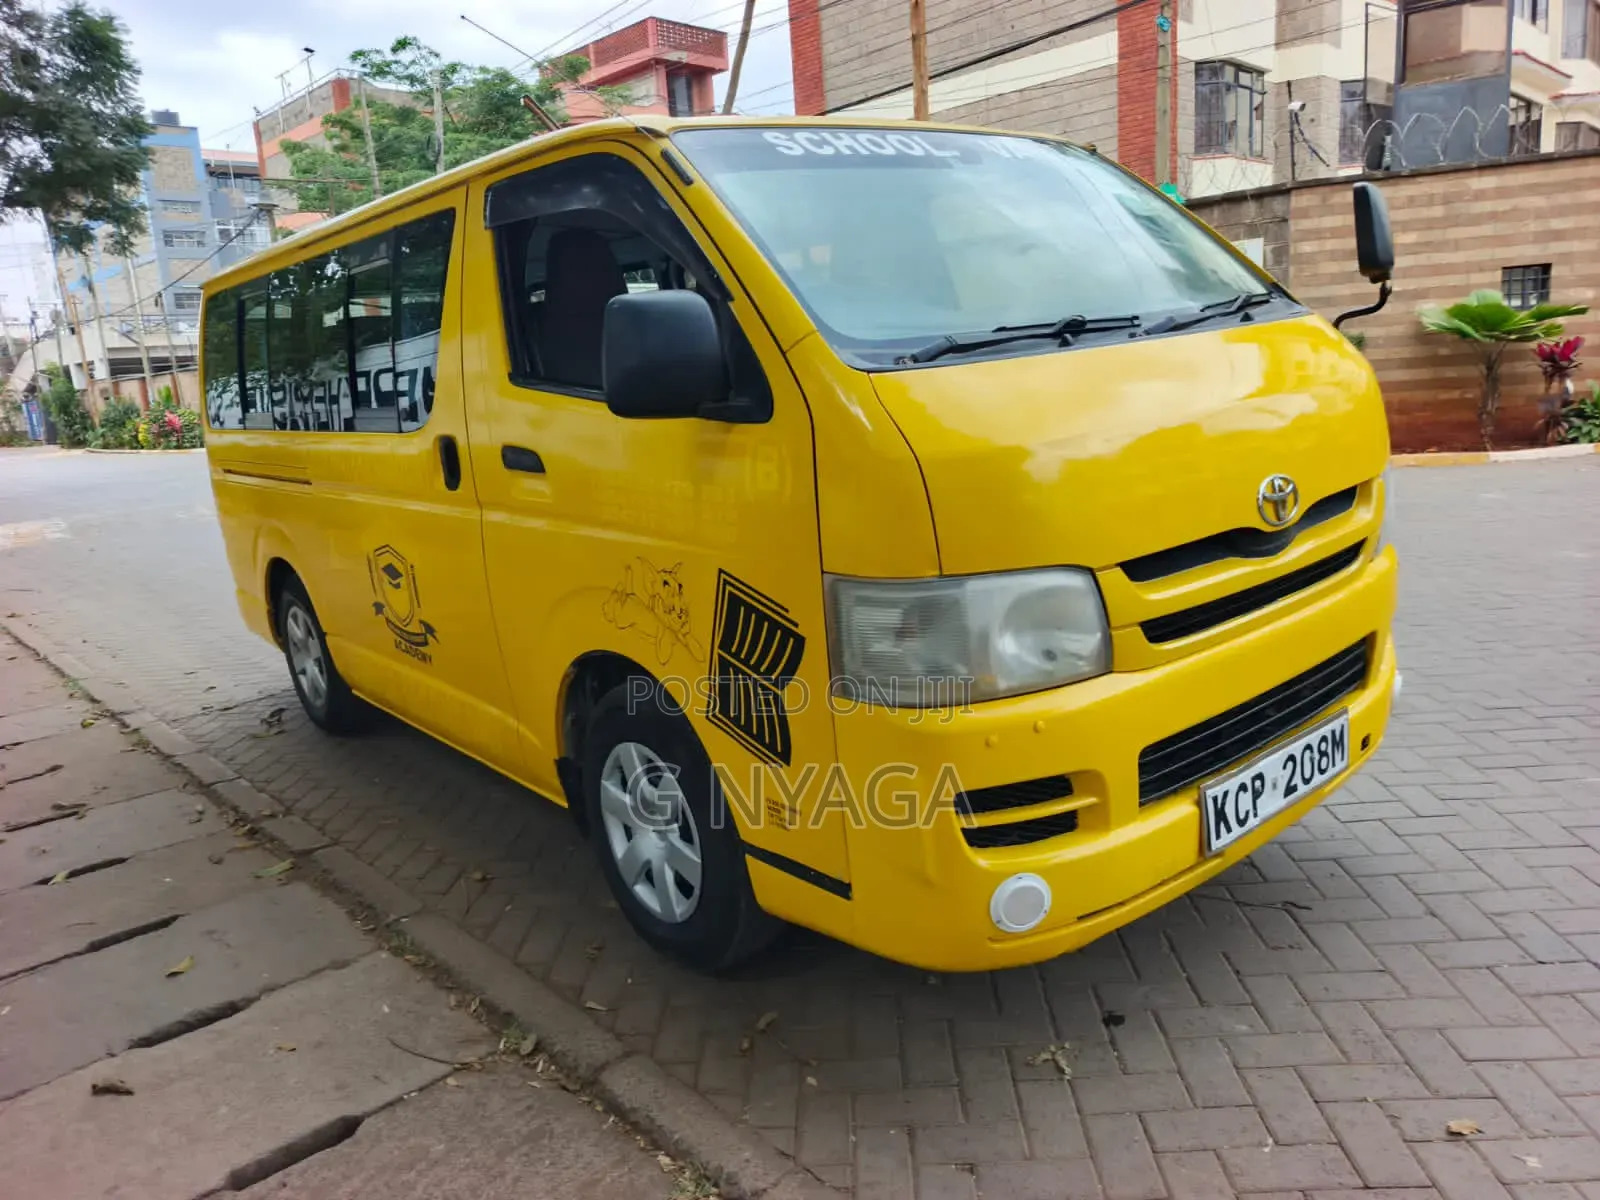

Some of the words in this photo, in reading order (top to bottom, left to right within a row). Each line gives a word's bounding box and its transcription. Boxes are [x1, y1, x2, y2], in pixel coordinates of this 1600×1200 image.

[762, 131, 960, 157] SCHOOL
[1211, 771, 1265, 841] KCP
[1282, 723, 1345, 799] 208M
